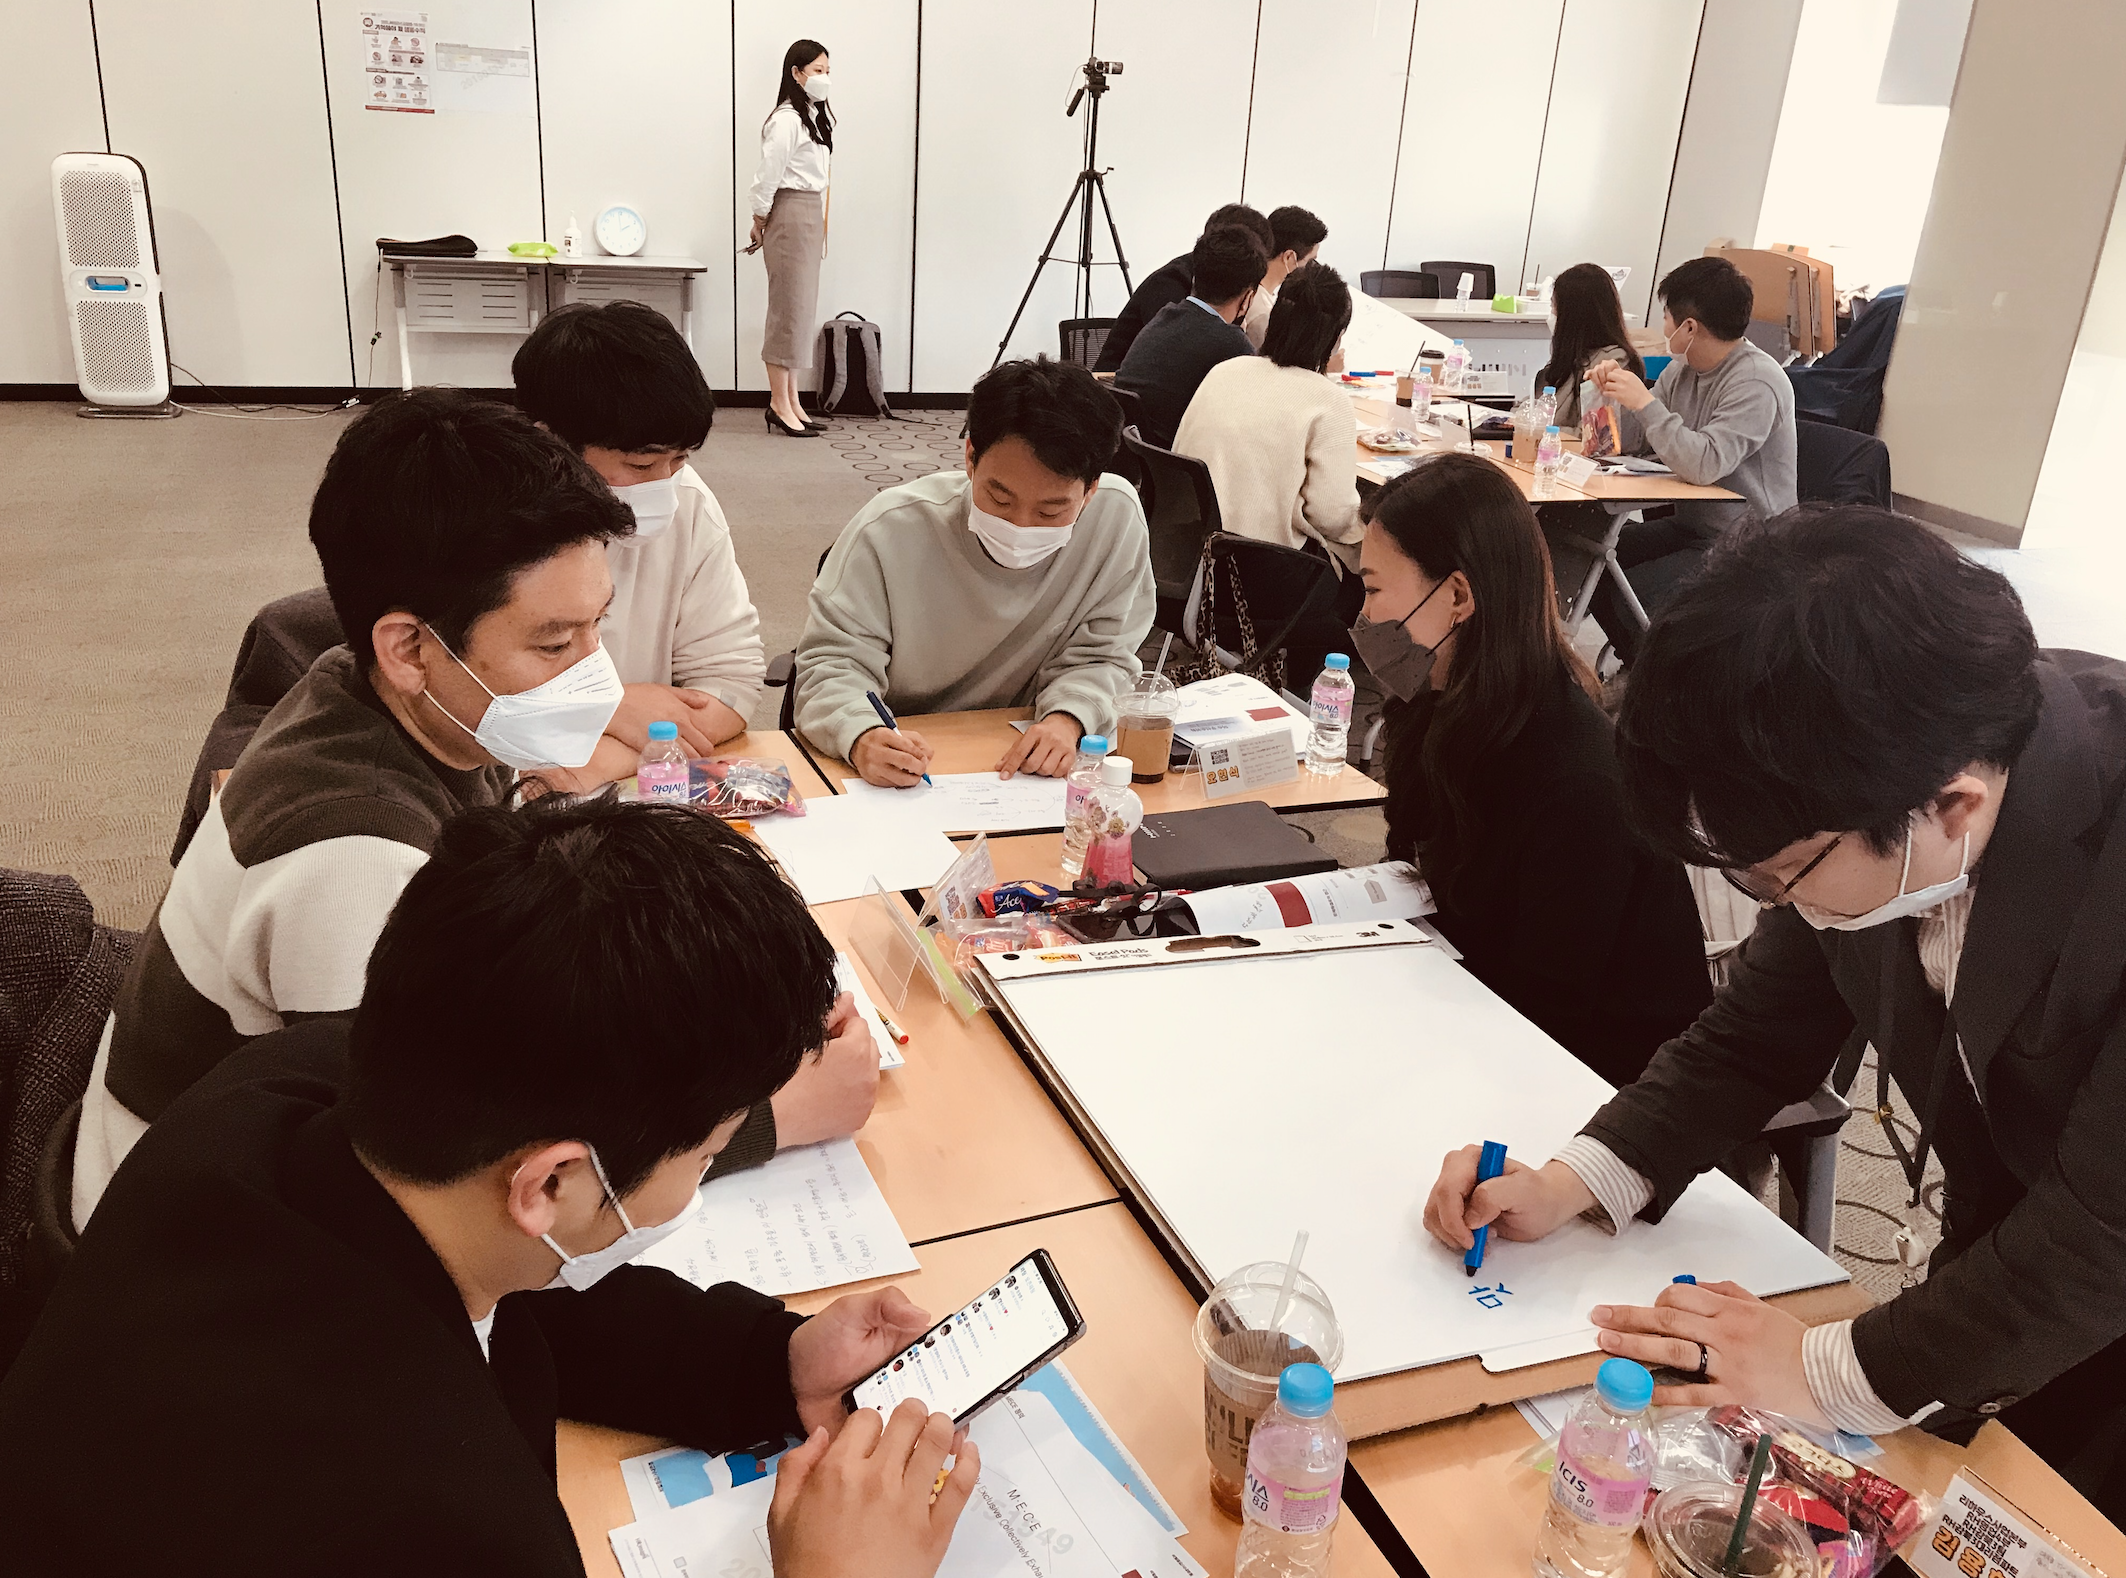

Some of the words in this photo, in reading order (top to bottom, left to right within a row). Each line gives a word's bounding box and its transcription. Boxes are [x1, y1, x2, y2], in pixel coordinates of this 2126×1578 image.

[1558, 1461, 1588, 1492] ICIS
[1252, 1495, 1269, 1512] 8.0
[1576, 1494, 1594, 1508] 8.0
[978, 1485, 1002, 1519] Exclusive
[999, 1519, 1029, 1558] Collectively
[1025, 1558, 1044, 1578] Exha
